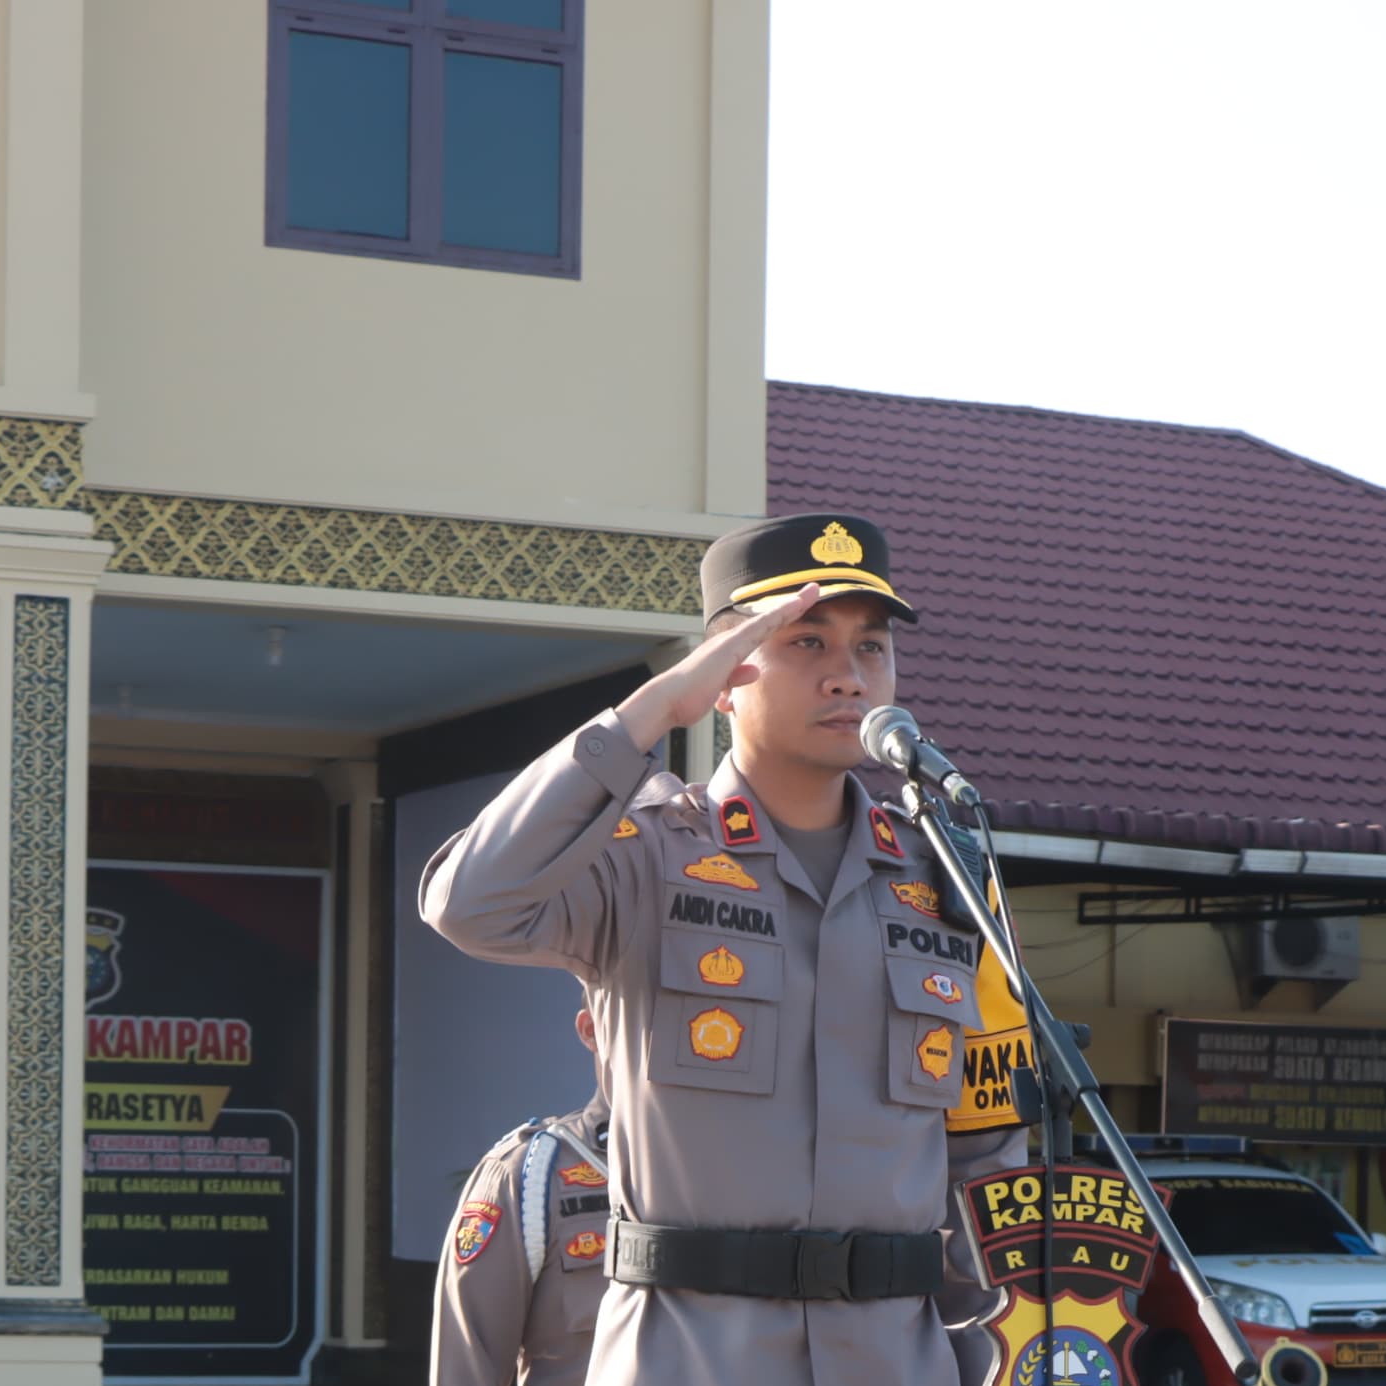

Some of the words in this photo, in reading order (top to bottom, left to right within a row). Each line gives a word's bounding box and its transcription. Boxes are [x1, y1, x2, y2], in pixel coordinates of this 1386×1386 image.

[669, 892, 714, 926] ANDI
[716, 901, 776, 937] CAKRA
[887, 923, 973, 967] POLRI
[87, 1017, 250, 1062] KAMPAR
[963, 1038, 1038, 1088] WAKA
[85, 1093, 204, 1122] RASETYA
[984, 1174, 1146, 1213] POLRES
[991, 1204, 1145, 1235] KAMPAR
[84, 1269, 173, 1285] ERDASARKAN
[1005, 1245, 1130, 1273] RAU
